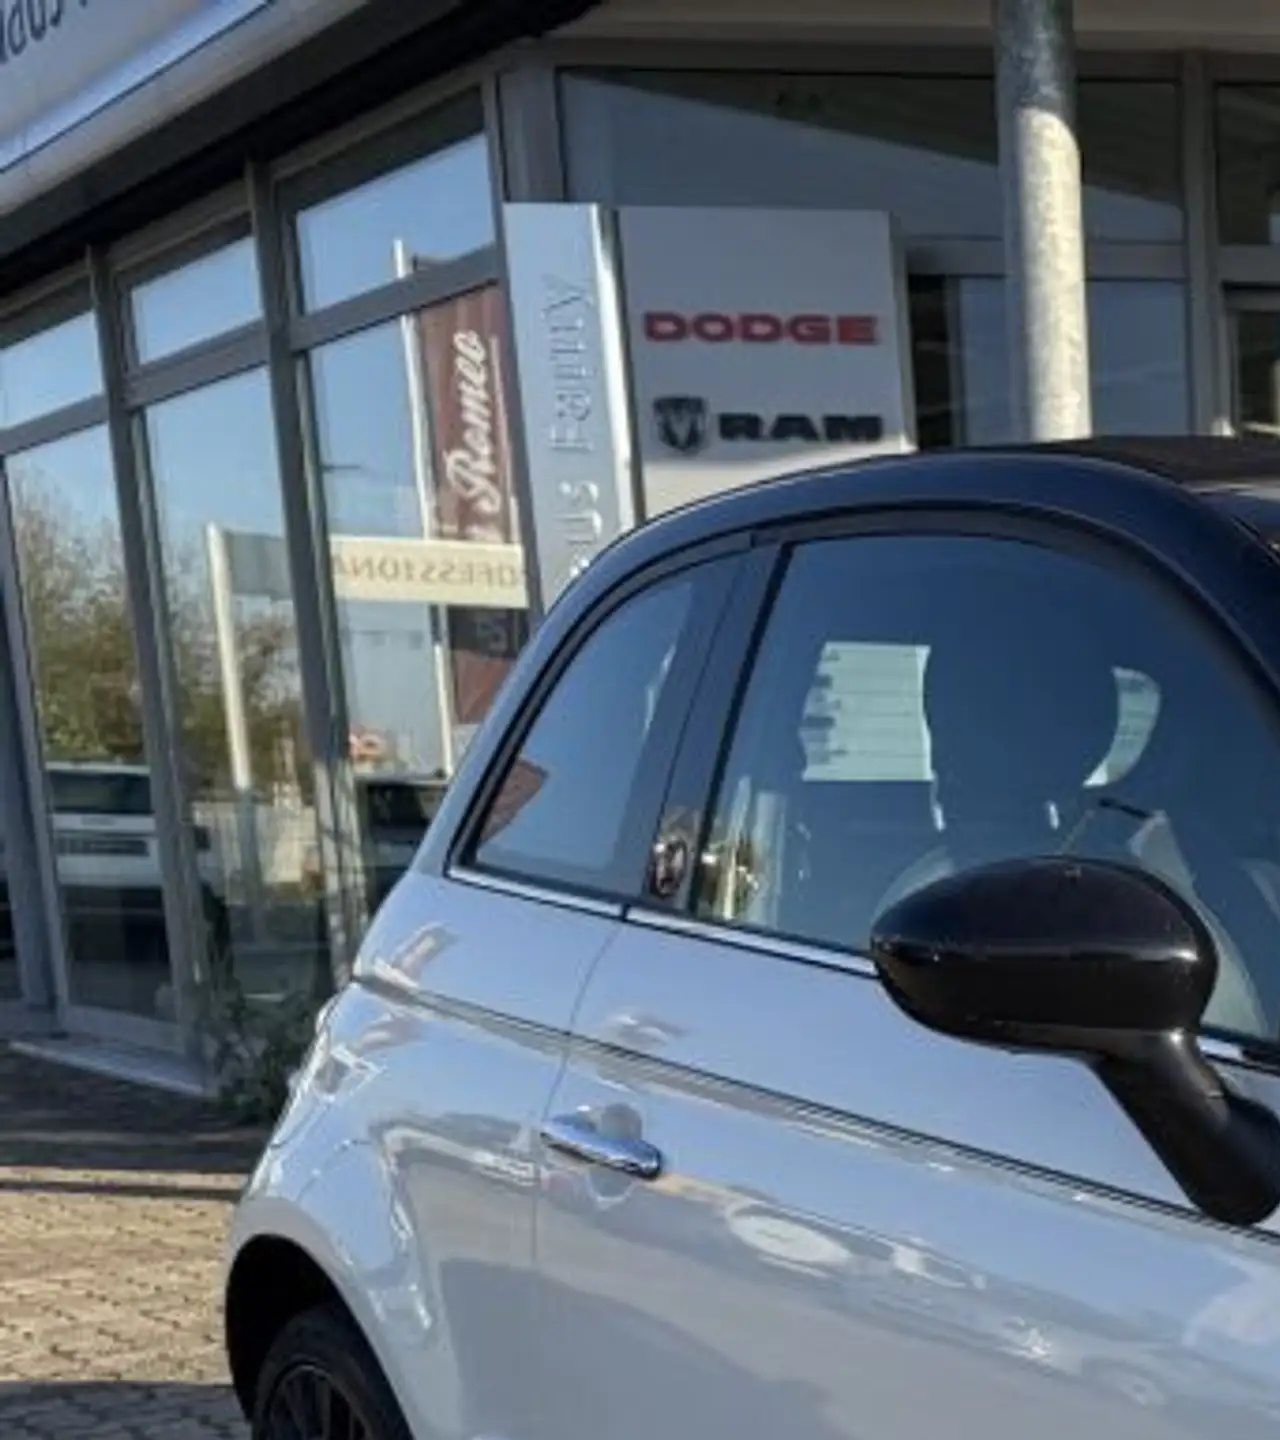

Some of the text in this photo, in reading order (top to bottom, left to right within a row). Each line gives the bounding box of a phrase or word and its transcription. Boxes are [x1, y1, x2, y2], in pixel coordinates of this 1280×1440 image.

[644, 312, 879, 346] DODGE
[444, 328, 501, 514] Romeo
[718, 413, 883, 442] RAM
